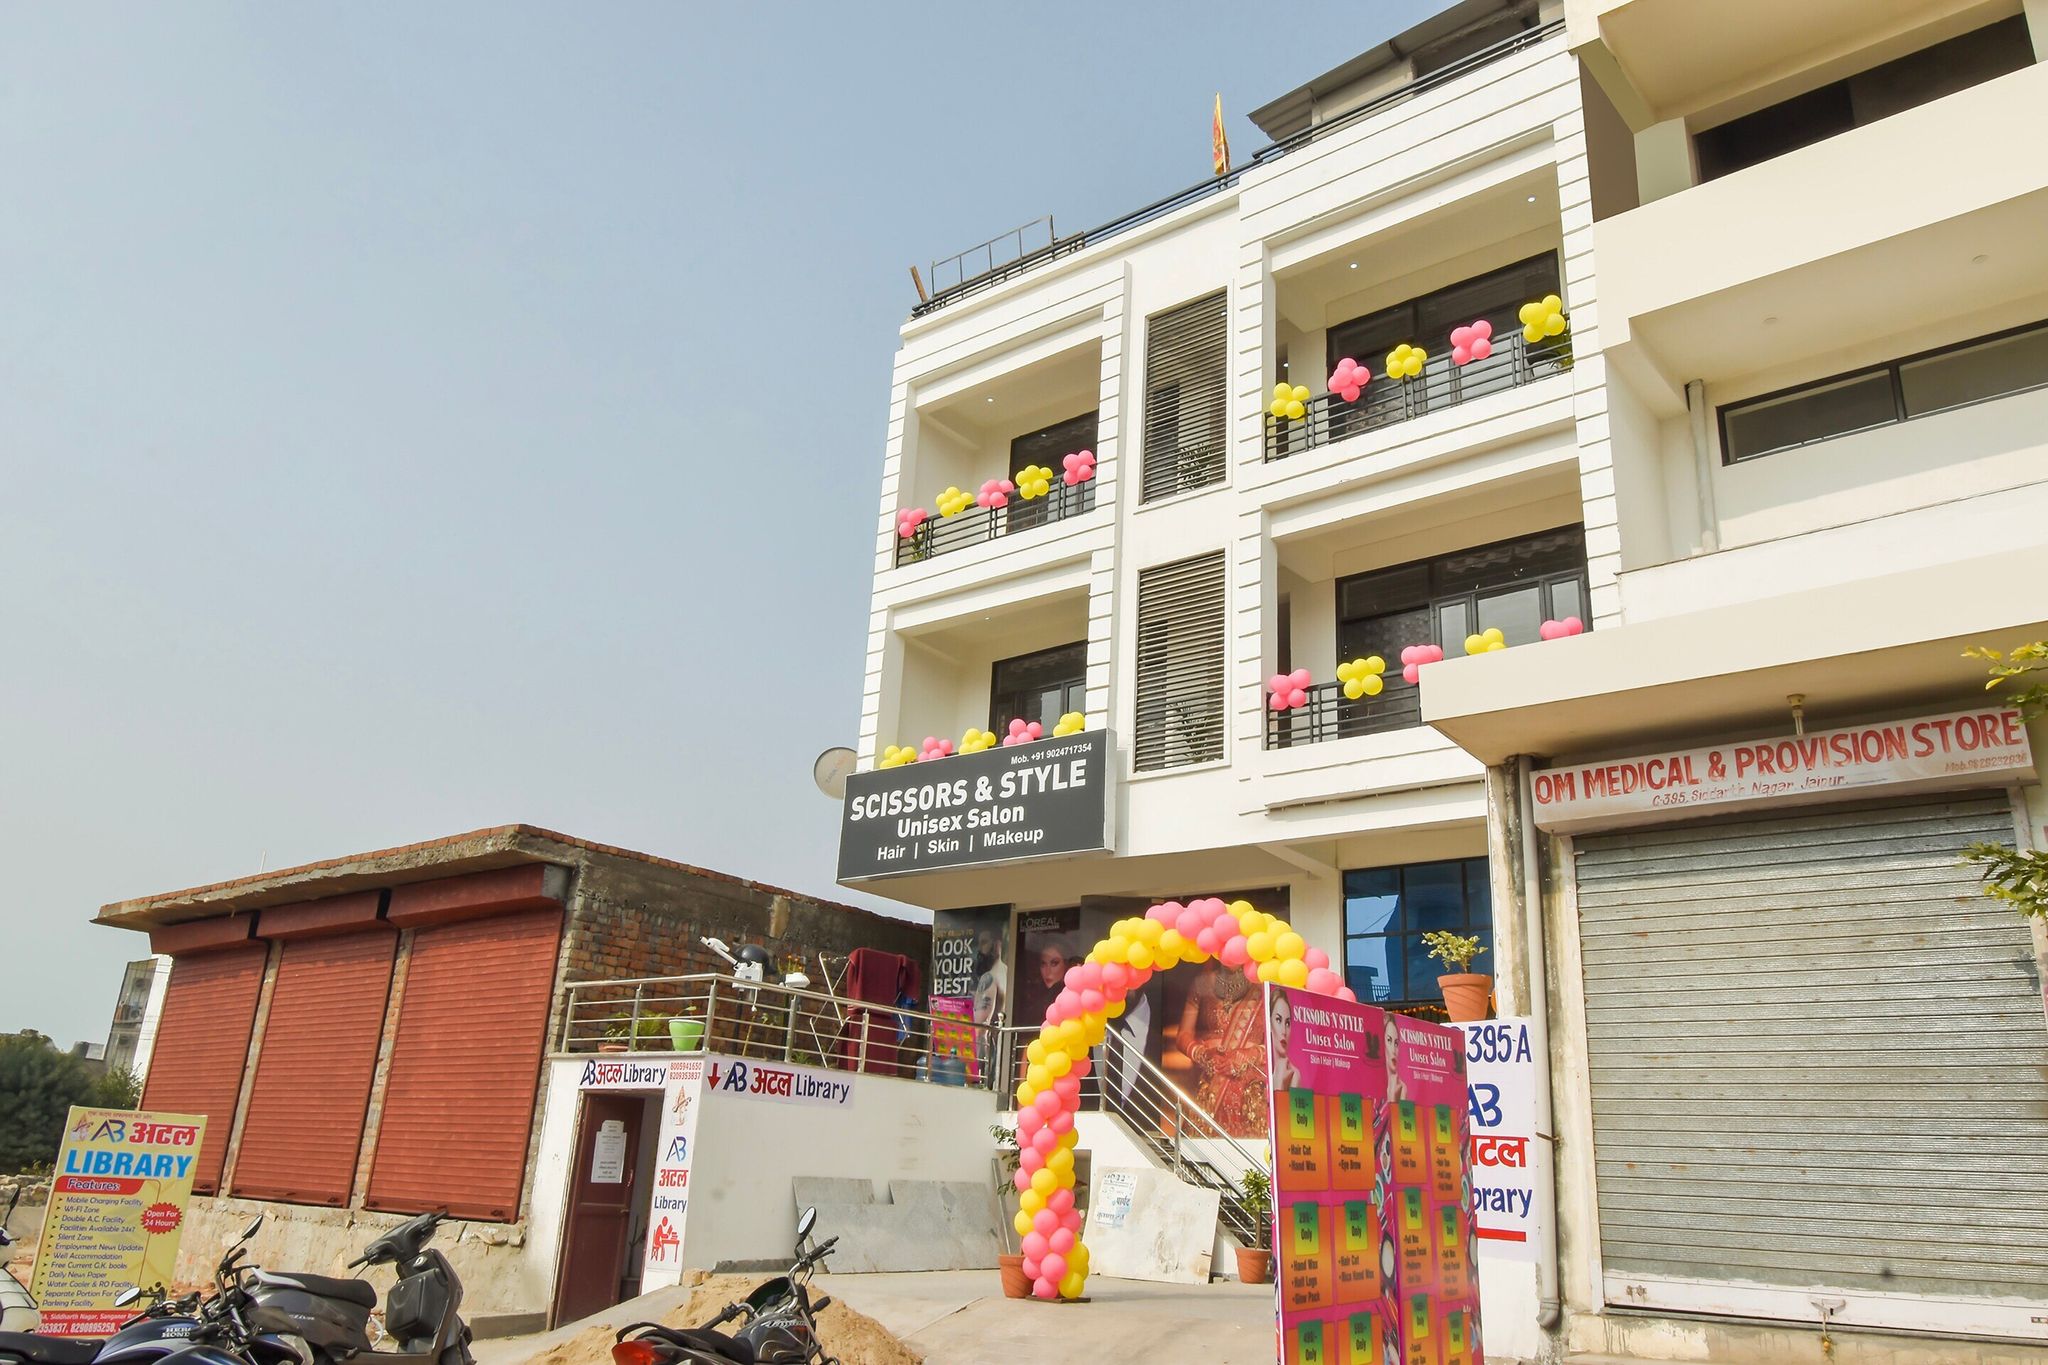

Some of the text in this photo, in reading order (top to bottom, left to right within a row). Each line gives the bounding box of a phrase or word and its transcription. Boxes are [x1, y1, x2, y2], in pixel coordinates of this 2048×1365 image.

[1010, 743, 1092, 765] Mob. +91 9024717354
[1535, 772, 1576, 804] OM
[1582, 755, 1699, 800] MEDICAL
[1708, 751, 1726, 781] &
[1734, 726, 1909, 779] PROVISION
[1911, 710, 2023, 758] STORE
[850, 759, 1087, 821] SCISSORS & STYLE
[897, 805, 1025, 839] Unisex Salon
[877, 845, 906, 861] Hair
[927, 838, 960, 854] Skin
[983, 828, 1044, 847] Makeup
[936, 937, 974, 957] LOOK
[934, 958, 973, 976] YOUR
[934, 977, 971, 995] BEST
[1293, 1006, 1330, 1027] SCISSORS
[1339, 1014, 1364, 1033] STYLE
[1400, 1028, 1427, 1047] SCISSORS
[1433, 1034, 1452, 1051] STYLE
[596, 1063, 623, 1085] अटल
[623, 1063, 667, 1085] Library
[750, 1068, 794, 1097] अटल
[796, 1075, 850, 1104] Library
[1296, 1113, 1308, 1127] Only
[129, 1122, 201, 1146] अटल
[1471, 1135, 1529, 1167] टल
[65, 1149, 192, 1178] LIBRARY
[659, 1169, 688, 1187] अटल
[66, 1196, 144, 1207] Mobile Charging Facility
[654, 1196, 687, 1213] Library
[101, 1216, 126, 1225] Facility
[146, 1210, 164, 1218] Open
[49, 1271, 66, 1279] Daily
[111, 1281, 134, 1289] Facility
[42, 1300, 94, 1308] Parking Facility
[44, 1290, 76, 1298] Separate
